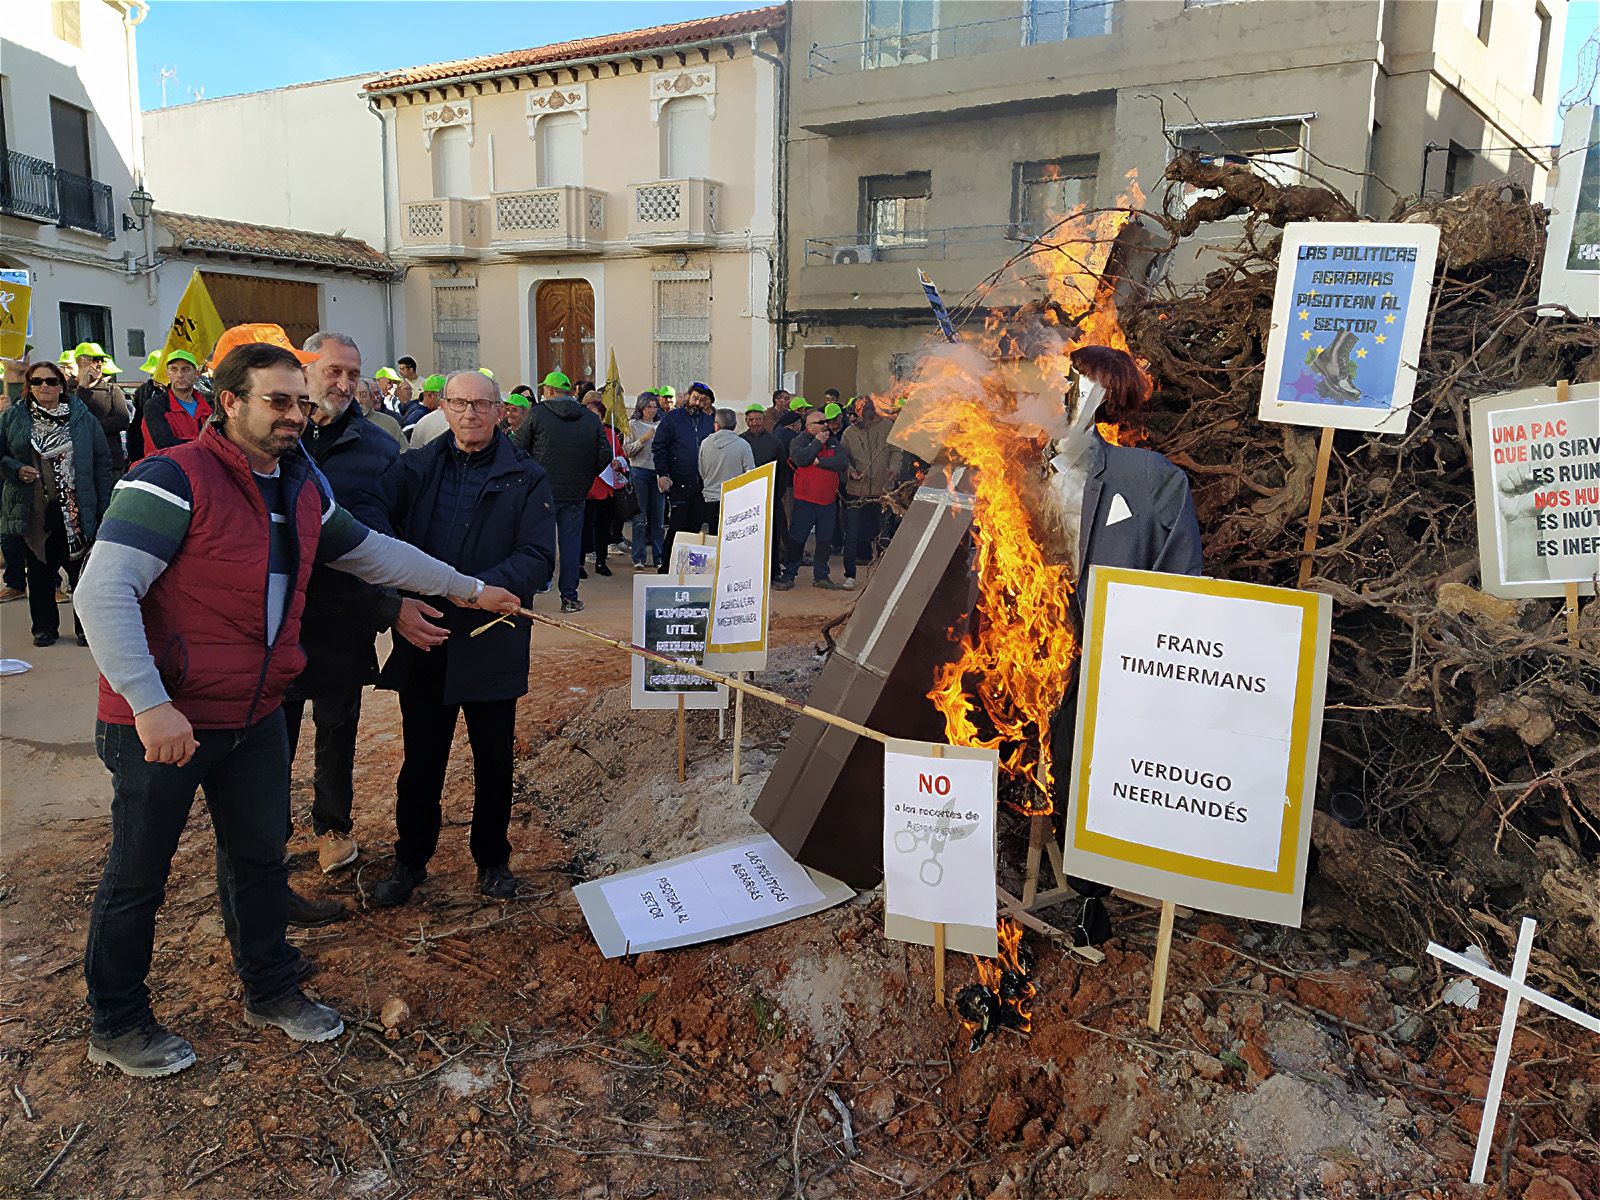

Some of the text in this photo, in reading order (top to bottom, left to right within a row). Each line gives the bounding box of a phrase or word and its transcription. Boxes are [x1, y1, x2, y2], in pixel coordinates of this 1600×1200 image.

[1298, 246, 1418, 262] LAS POLITICAS
[1312, 271, 1394, 286] AGRARIAS
[1297, 293, 1402, 310] PISOTEAN AL
[1313, 318, 1378, 333] SECTOR
[1492, 419, 1567, 444] UNA PAC
[1494, 445, 1527, 464] QUE
[1531, 442, 1554, 461] NO
[1533, 467, 1555, 484] ES
[1534, 489, 1571, 510] NOS
[1537, 513, 1558, 531] ES
[1537, 539, 1558, 557] ES
[675, 591, 690, 602] LA
[1156, 633, 1225, 658] FRANS
[1120, 655, 1267, 693] TIMMERMANS
[918, 773, 951, 796] NO
[1130, 758, 1233, 793] VERDUGO
[894, 803, 980, 820] a los recortes de
[1112, 781, 1249, 824] NEERLANDÉS
